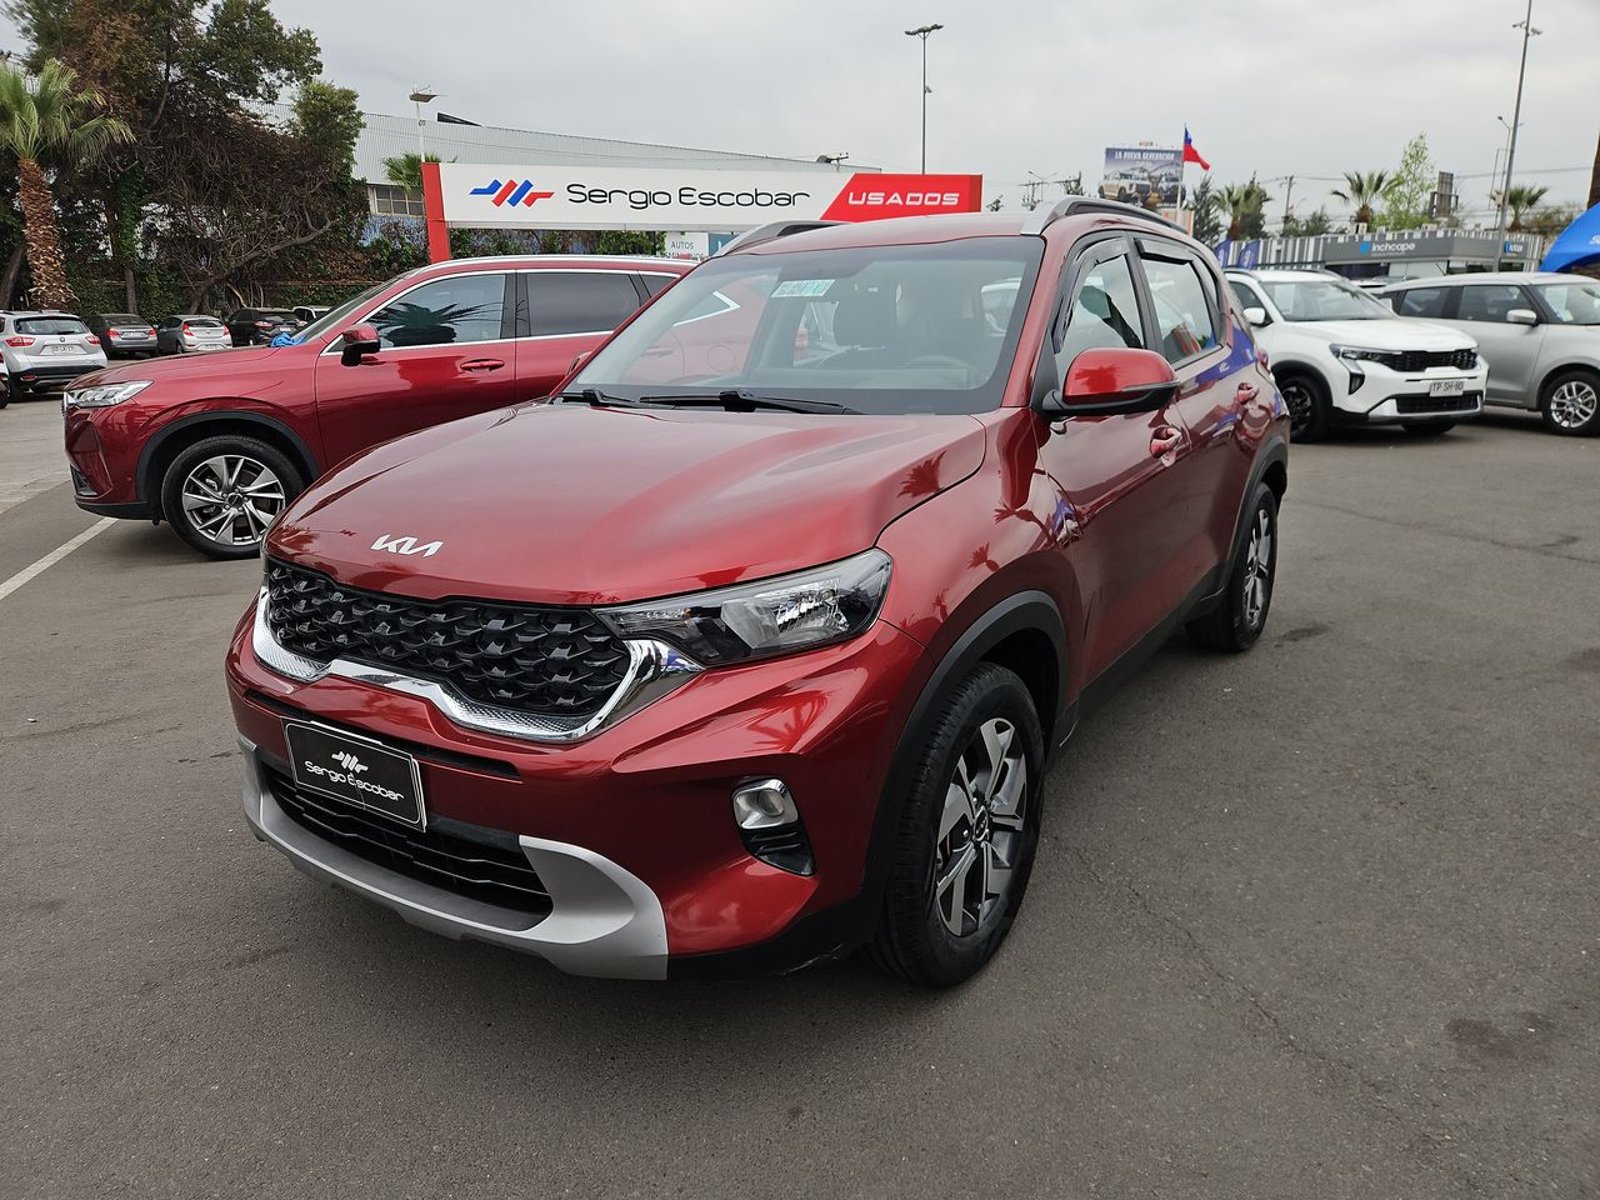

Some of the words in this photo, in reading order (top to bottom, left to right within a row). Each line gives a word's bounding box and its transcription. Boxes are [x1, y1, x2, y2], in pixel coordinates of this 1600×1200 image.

[566, 183, 672, 210] Sergio
[678, 187, 811, 206] Escobar
[848, 191, 960, 206] USADOS
[670, 240, 695, 250] AUTOS
[370, 534, 444, 557] KIA
[347, 772, 405, 801] Escobar
